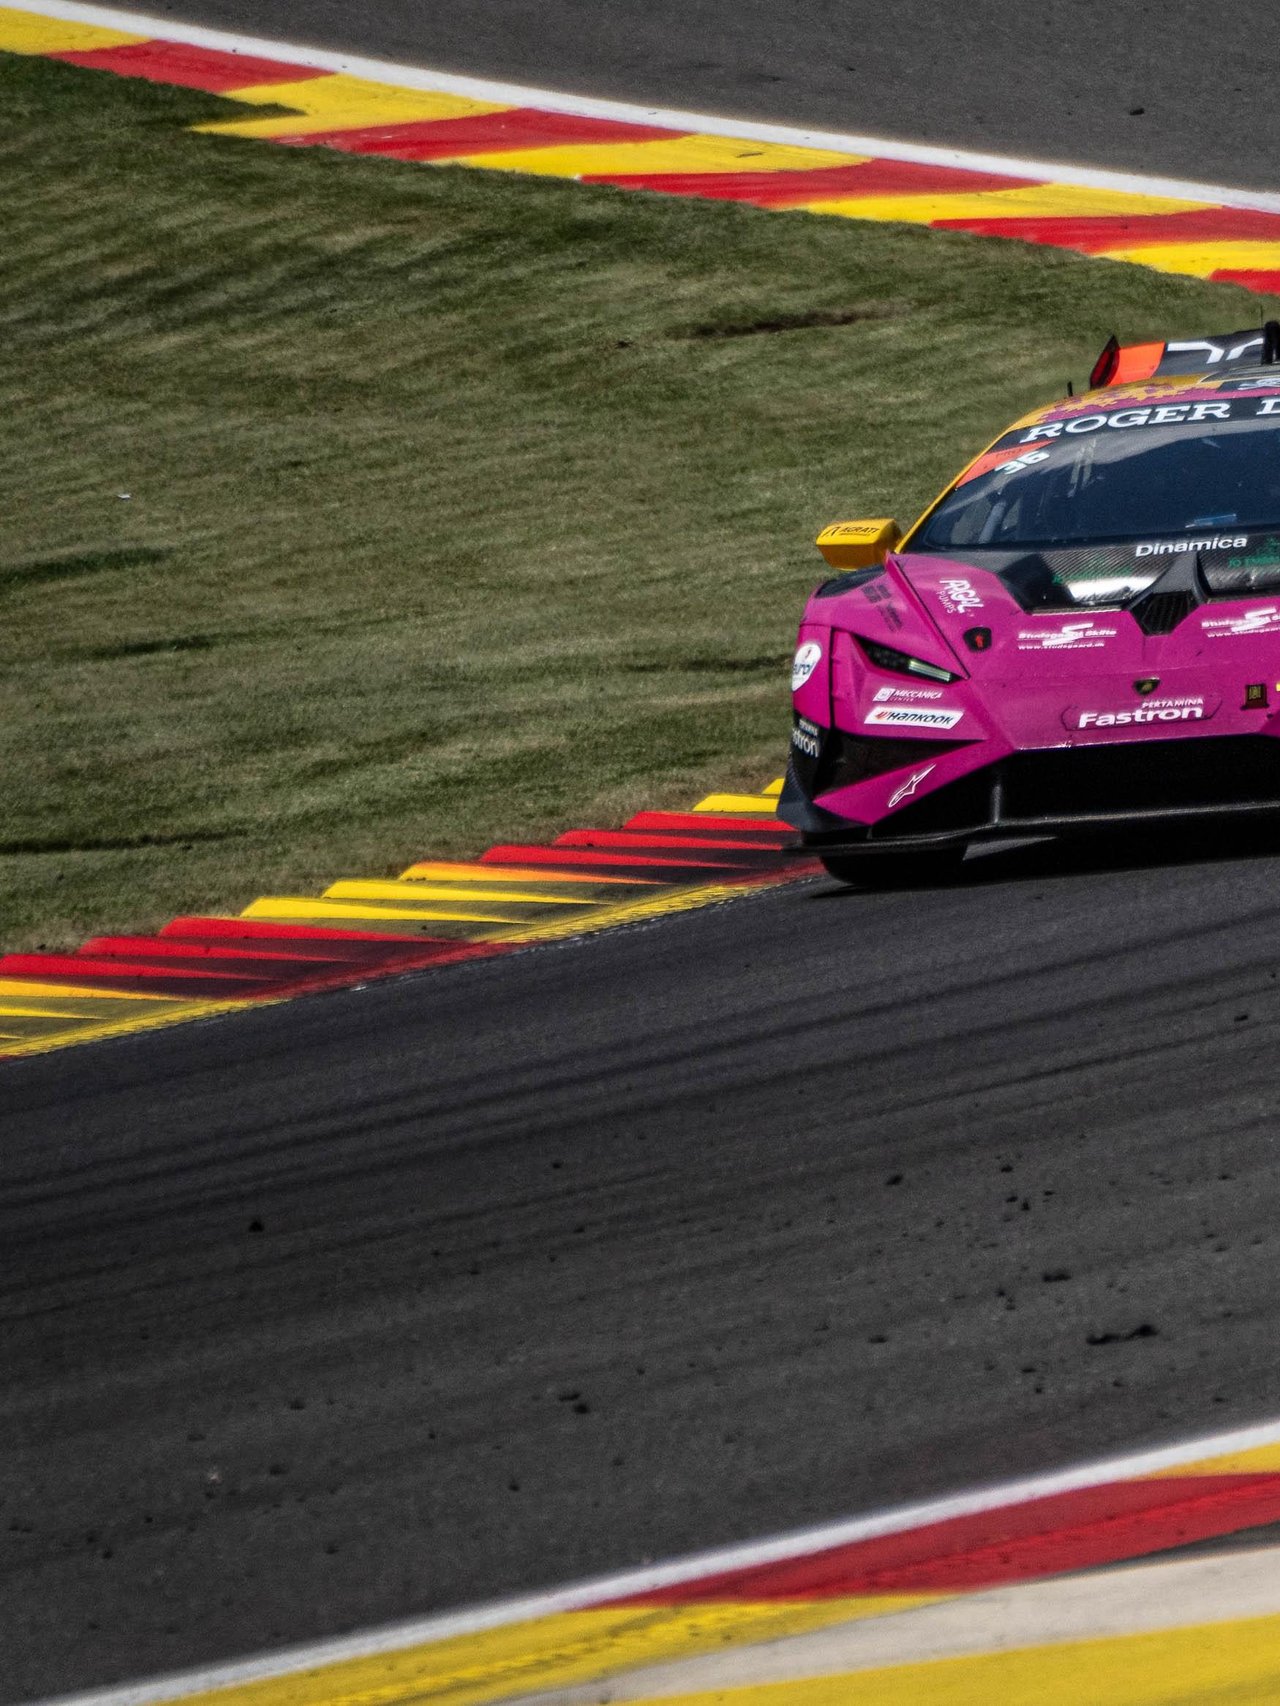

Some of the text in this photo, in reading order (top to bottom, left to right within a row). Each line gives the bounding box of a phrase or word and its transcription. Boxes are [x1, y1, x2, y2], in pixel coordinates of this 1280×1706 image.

[1019, 402, 1231, 443] ROGER
[994, 450, 1050, 475] 36
[1135, 534, 1248, 557] Dinamica
[939, 579, 984, 613] ARGAL
[1141, 698, 1204, 709] PERTAMINA
[1078, 706, 1203, 729] Fastron
